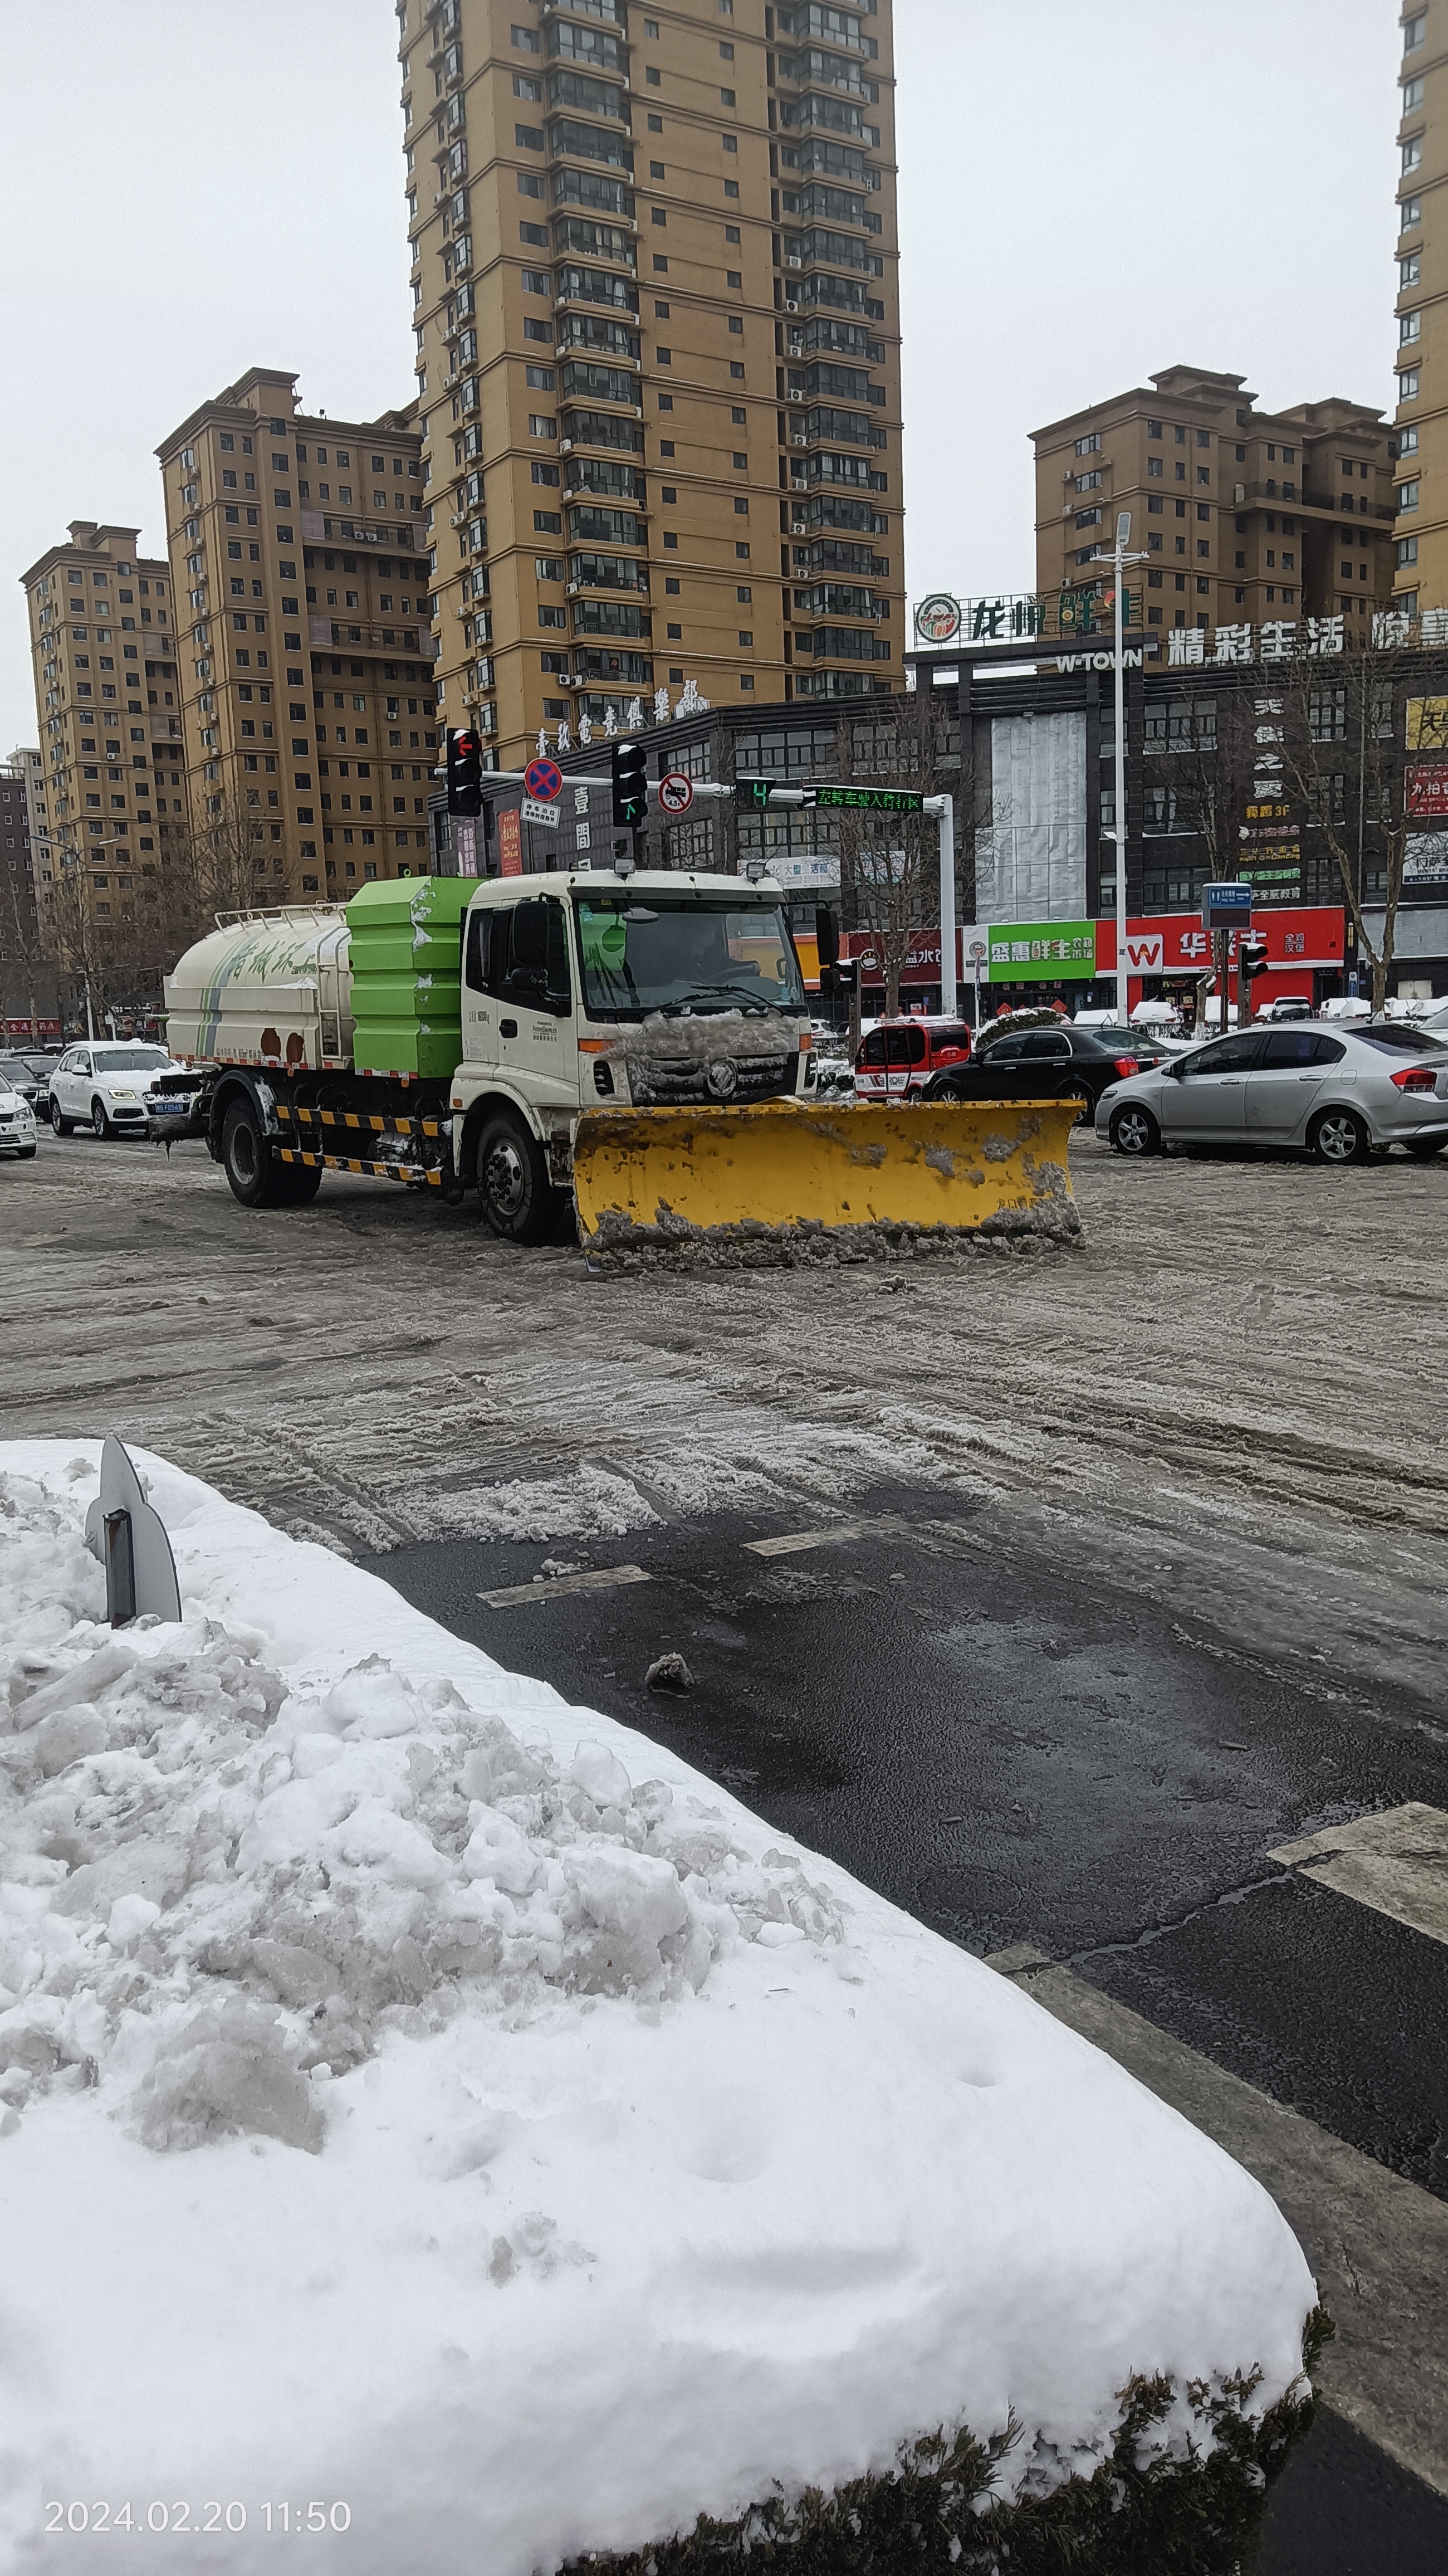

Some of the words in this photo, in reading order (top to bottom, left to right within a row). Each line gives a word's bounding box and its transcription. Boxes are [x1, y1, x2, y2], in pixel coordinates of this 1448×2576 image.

[972, 588, 1141, 640] 龙悦鲜生
[1168, 615, 1343, 666] 精彩生活
[754, 783, 766, 806] 4
[991, 939, 1072, 963] 盛惠鲜生
